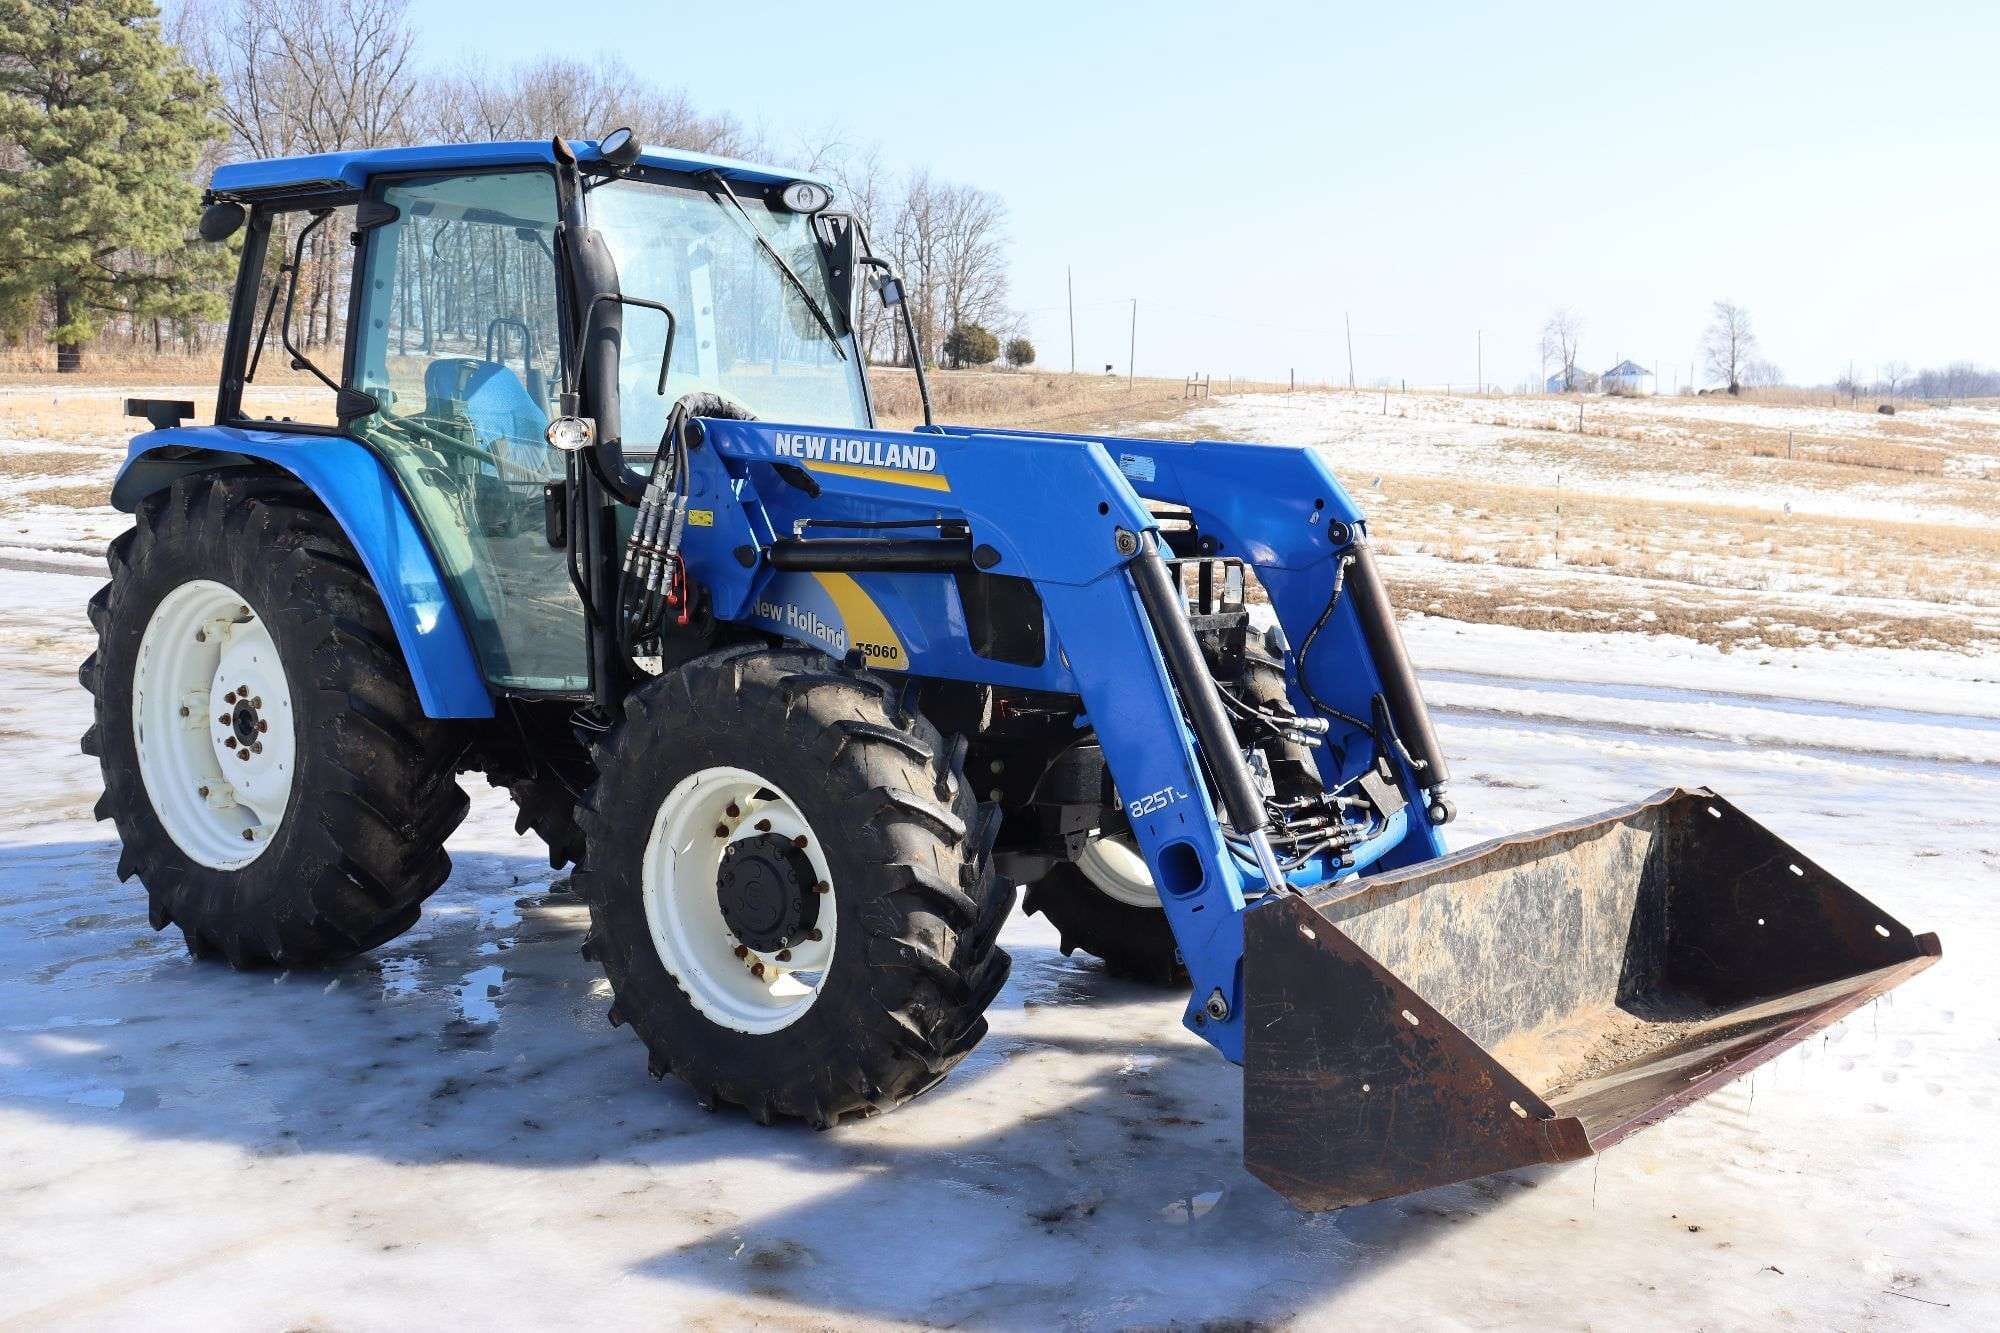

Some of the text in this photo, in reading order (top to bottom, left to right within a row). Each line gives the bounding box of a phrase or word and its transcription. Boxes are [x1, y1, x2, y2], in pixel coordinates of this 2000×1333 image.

[775, 432, 936, 471] NEW HOLLAND
[787, 603, 845, 648] Holland
